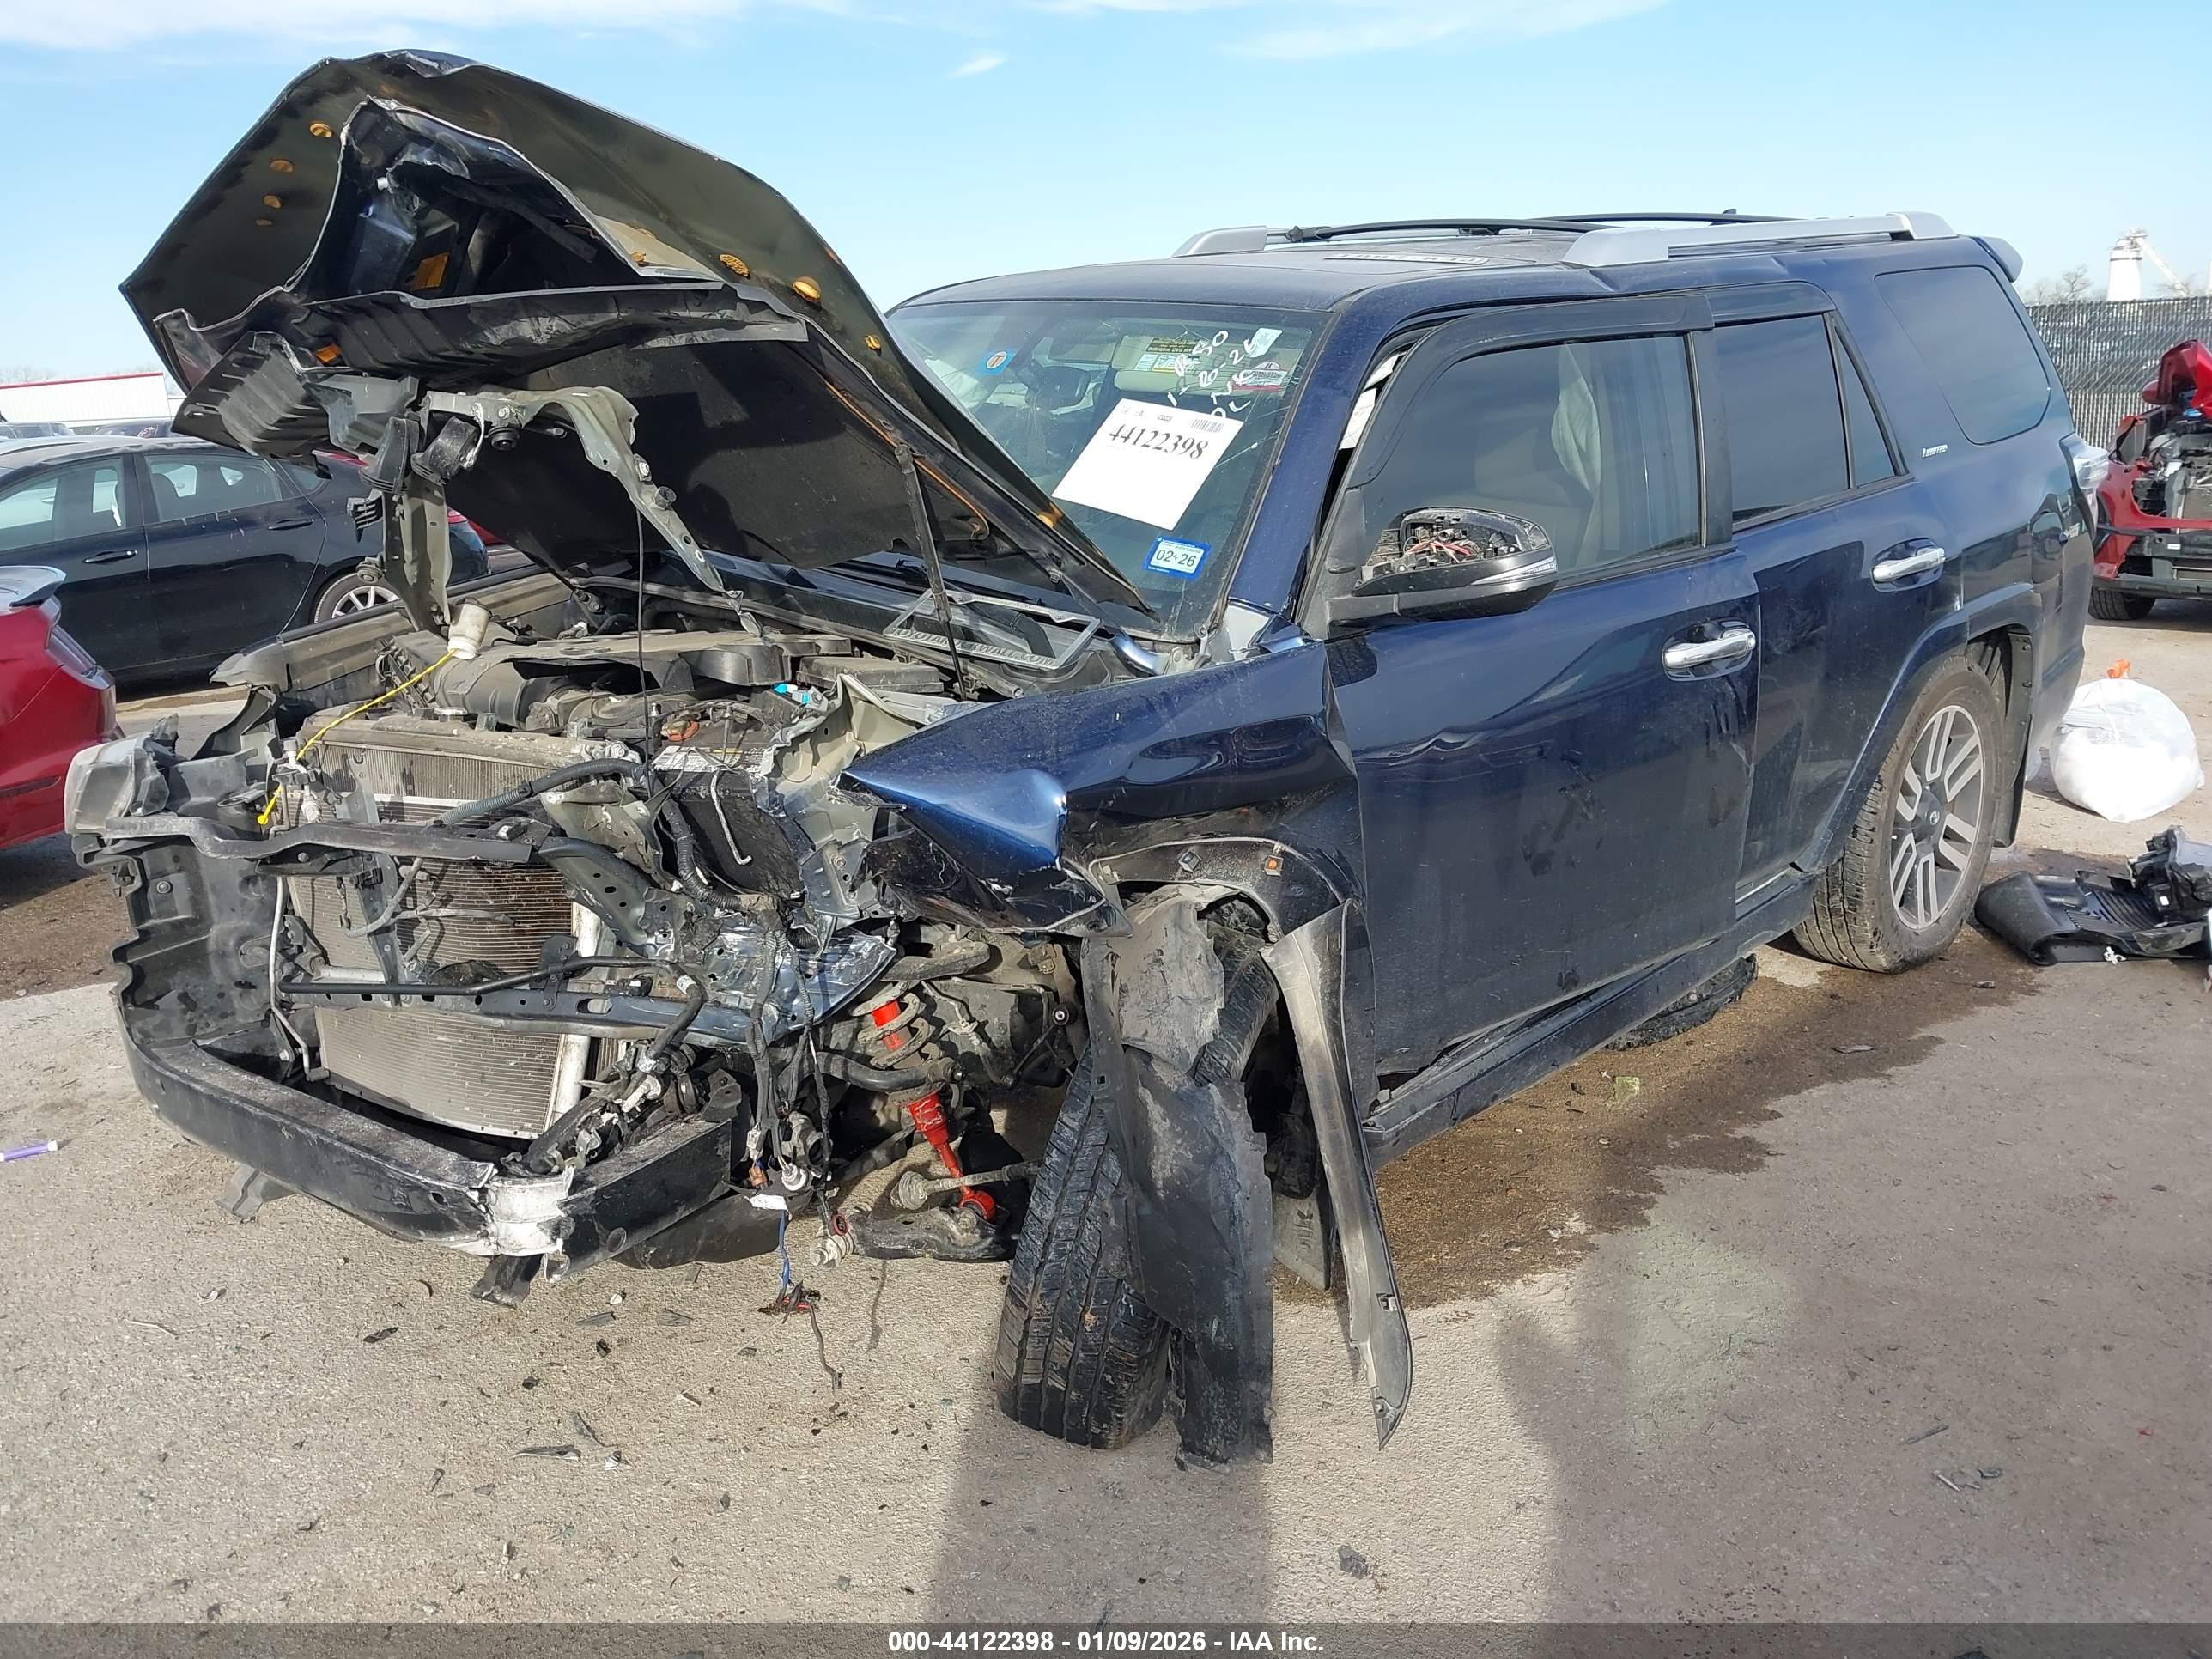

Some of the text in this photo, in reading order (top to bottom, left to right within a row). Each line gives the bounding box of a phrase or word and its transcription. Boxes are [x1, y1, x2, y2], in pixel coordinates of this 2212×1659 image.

[1109, 424, 1209, 459] 44122398
[1156, 549, 1197, 567] 02 26
